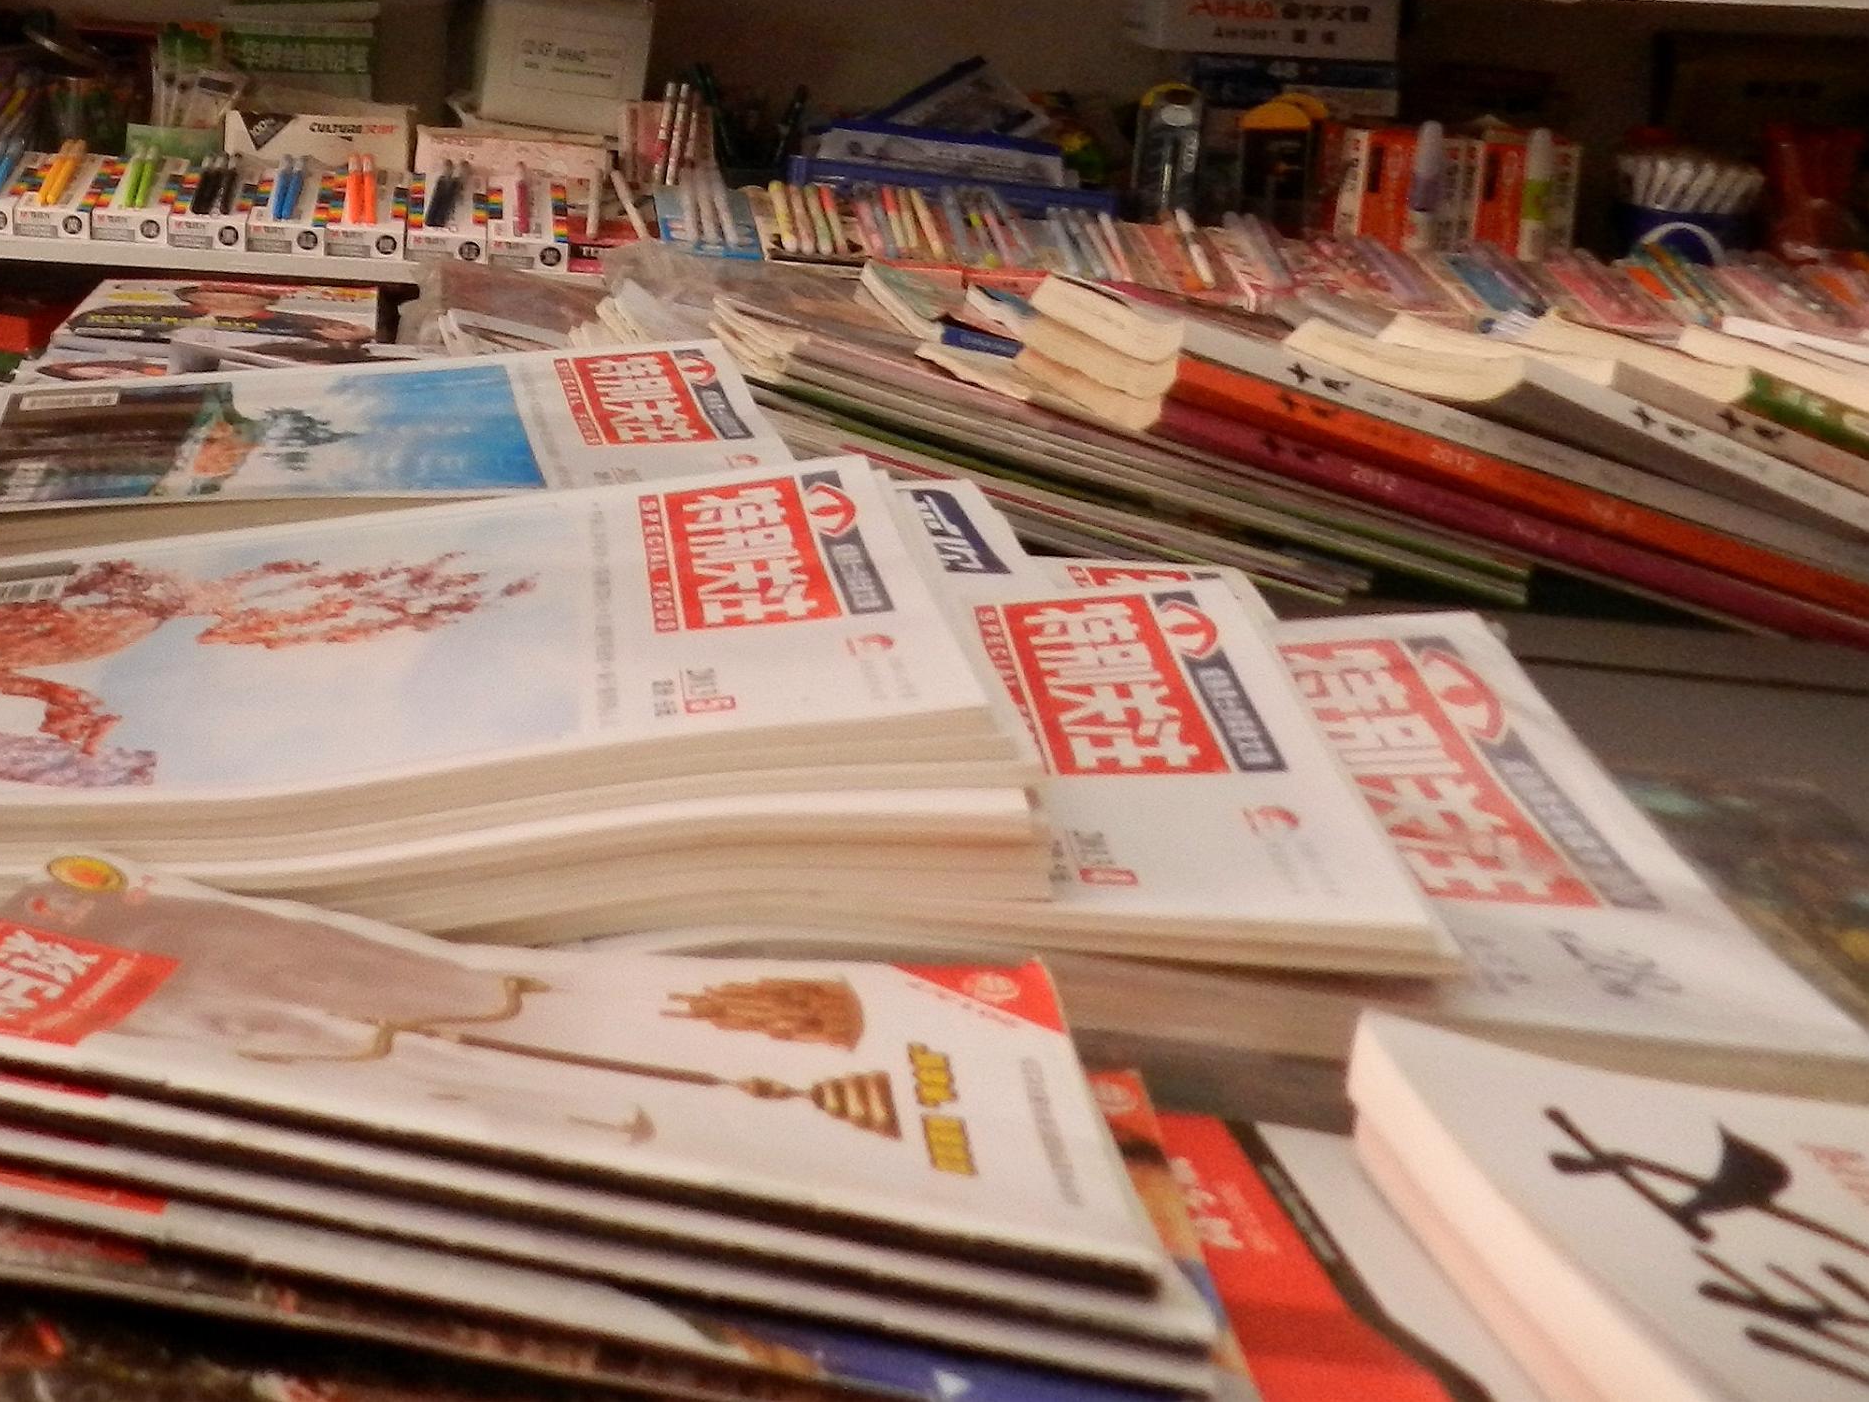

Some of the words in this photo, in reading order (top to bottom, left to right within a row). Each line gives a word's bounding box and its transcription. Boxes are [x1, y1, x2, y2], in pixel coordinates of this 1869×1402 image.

[586, 355, 699, 441] 特别关注
[640, 497, 671, 572] SPECIAL
[681, 487, 819, 625] 特别关注
[651, 580, 678, 633] FOCUS
[1024, 602, 1201, 769] 特别关注
[1283, 647, 1564, 897] 特别关注
